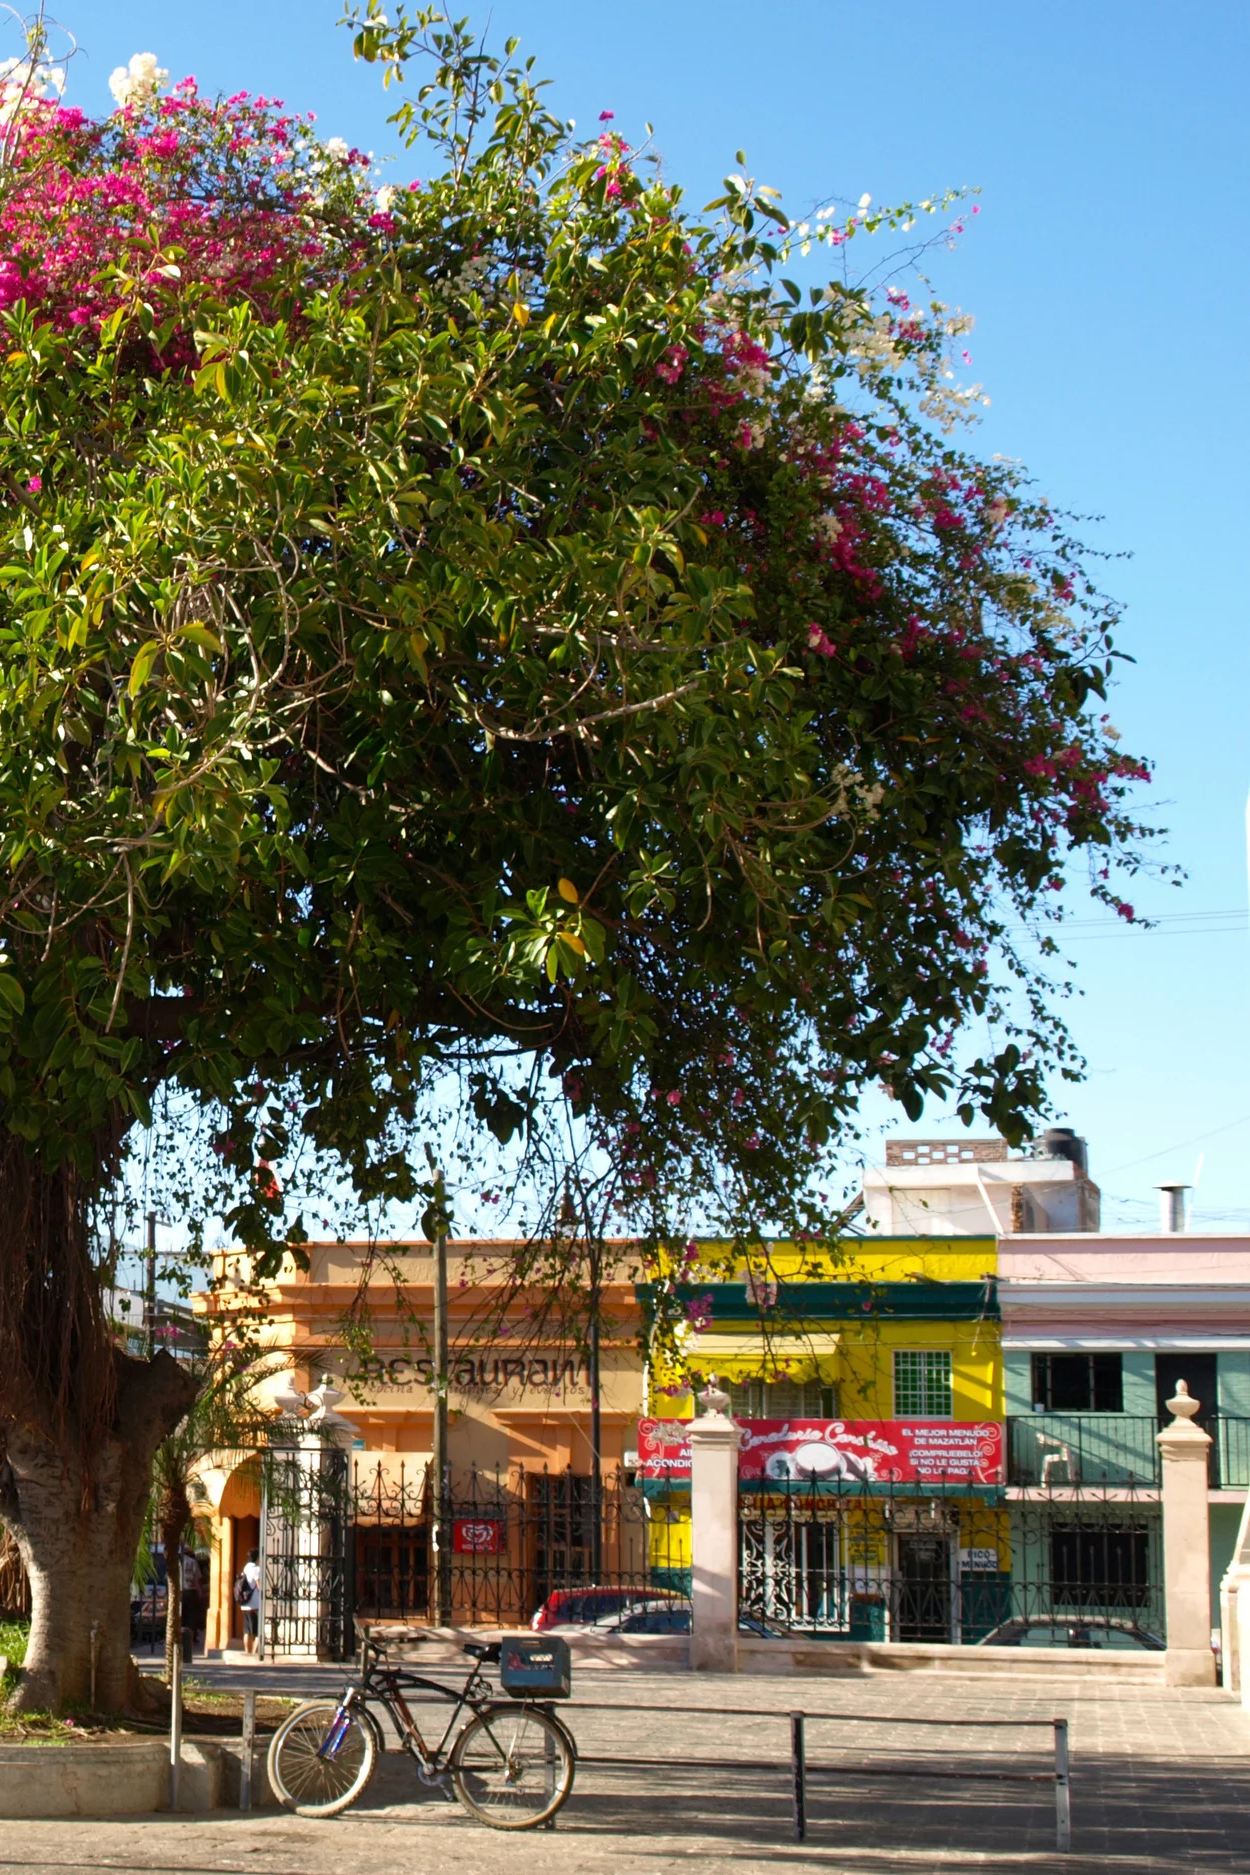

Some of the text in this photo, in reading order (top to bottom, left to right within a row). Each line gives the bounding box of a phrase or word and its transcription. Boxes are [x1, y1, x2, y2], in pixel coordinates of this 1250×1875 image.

[902, 1428, 990, 1437] EL MEJOR MENUDO
[917, 1467, 931, 1475] NO
